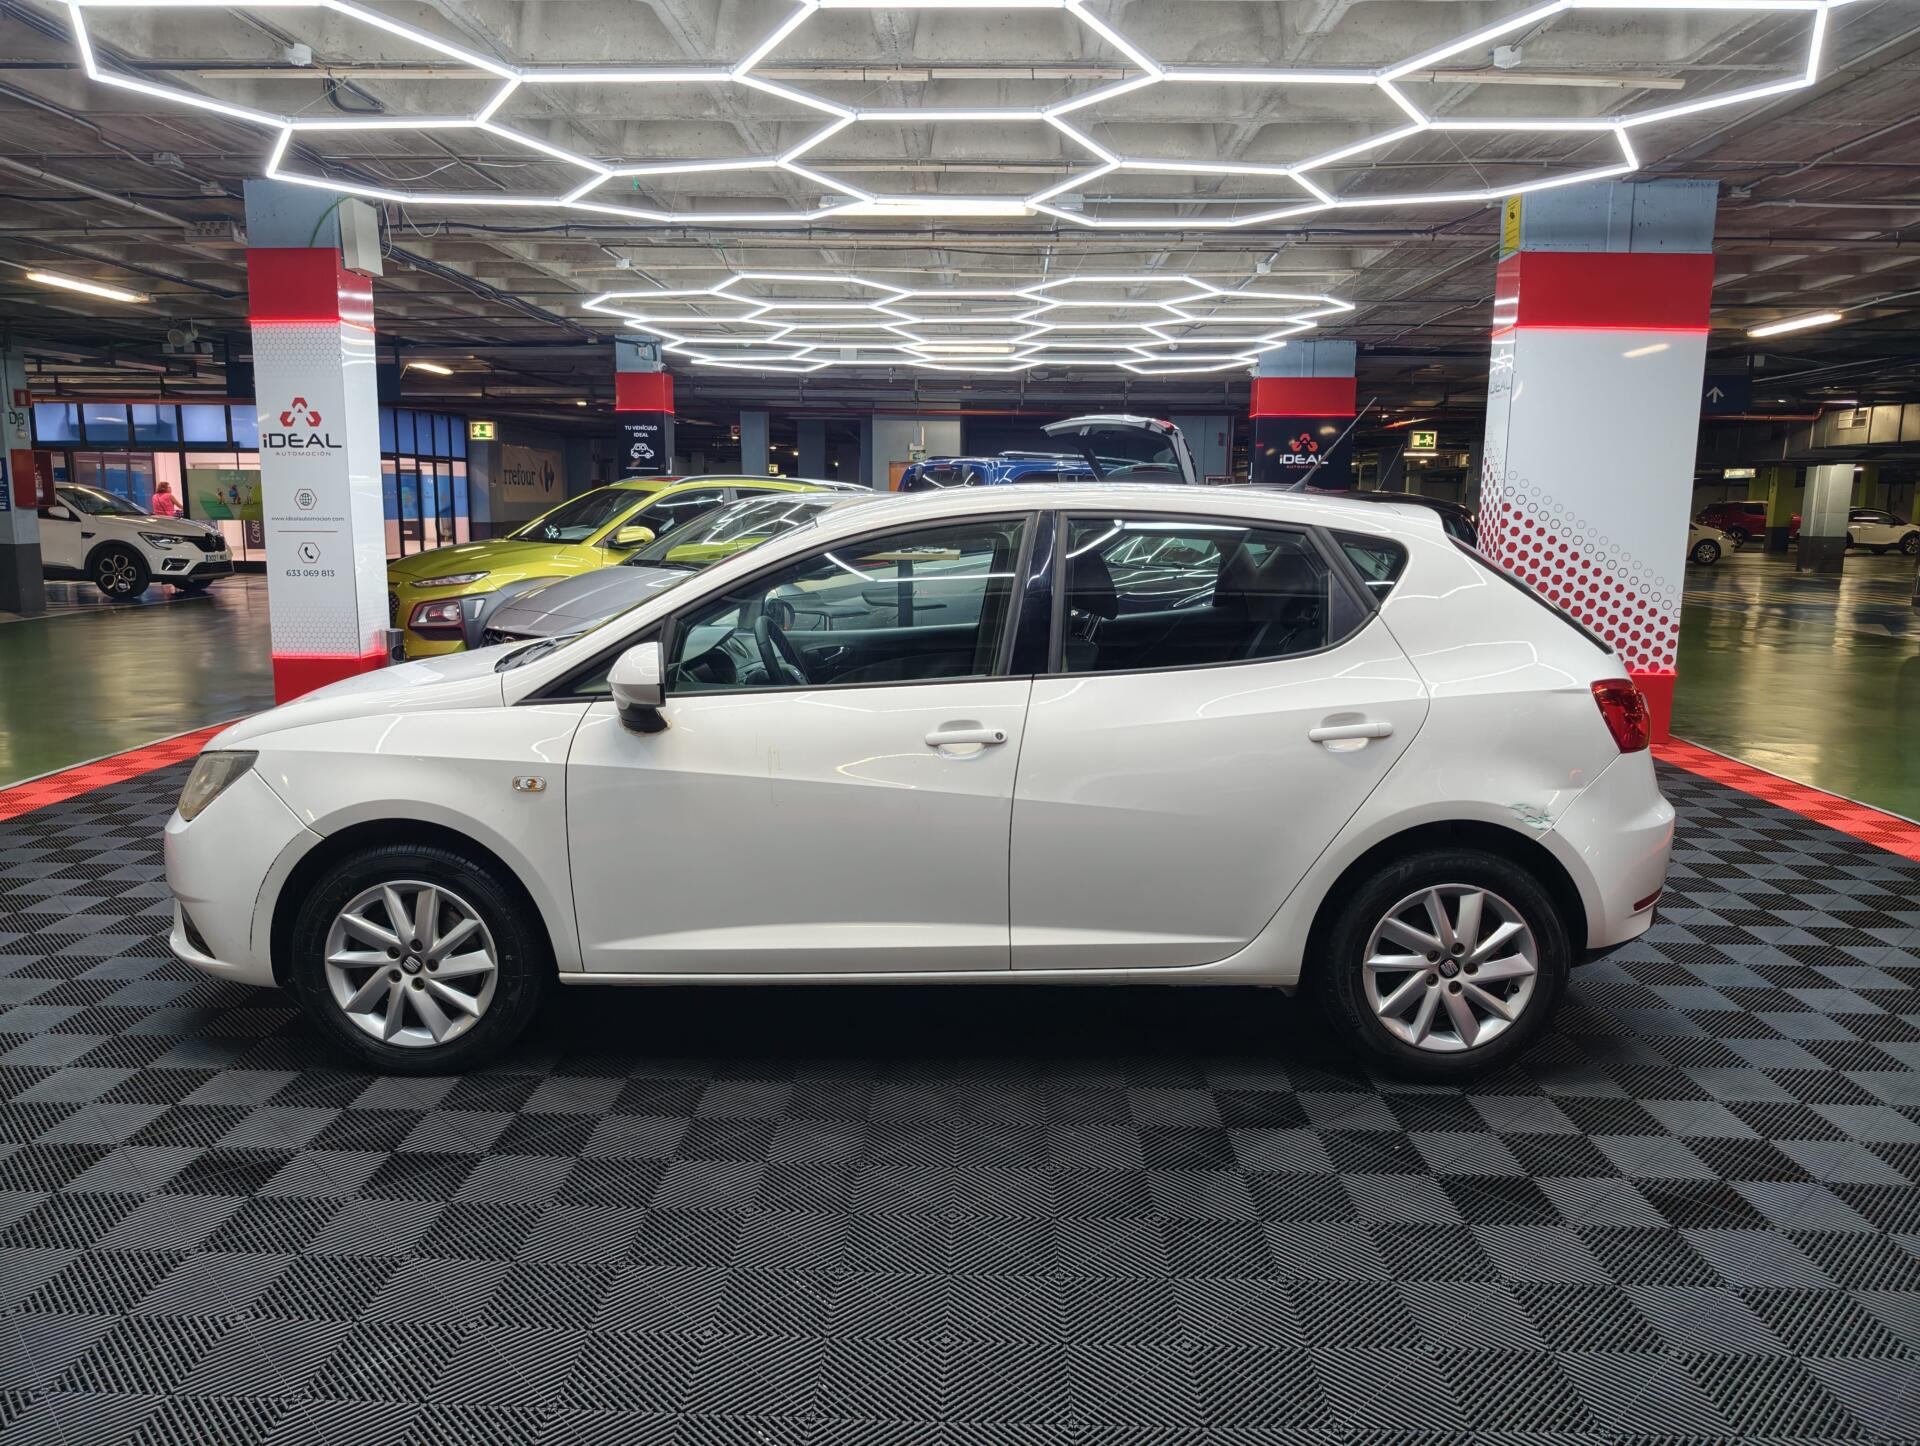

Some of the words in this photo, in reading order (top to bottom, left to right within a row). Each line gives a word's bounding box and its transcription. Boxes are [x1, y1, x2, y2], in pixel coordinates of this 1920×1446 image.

[286, 569, 301, 577] 633
[303, 569, 319, 577] 069
[321, 569, 335, 577] 813
